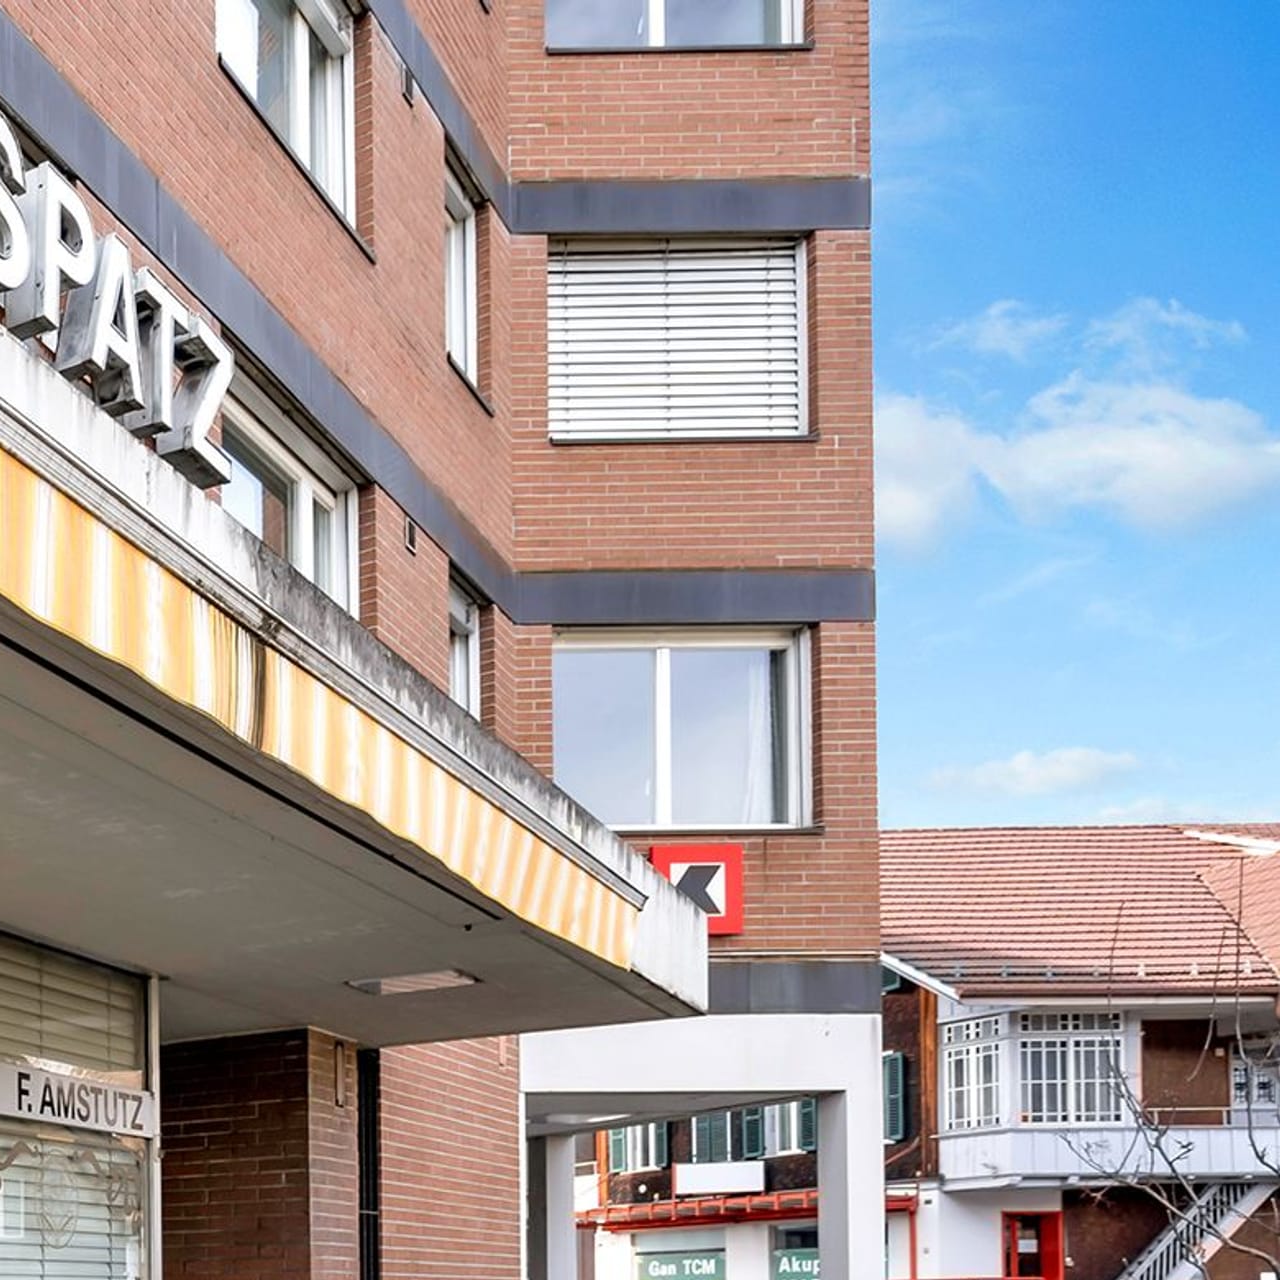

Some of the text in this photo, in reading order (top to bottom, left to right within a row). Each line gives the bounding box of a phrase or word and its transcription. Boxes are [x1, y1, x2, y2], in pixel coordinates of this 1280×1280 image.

[17, 1071, 144, 1131] F. AMSTUTZ
[648, 1258, 716, 1277] Gan TCM
